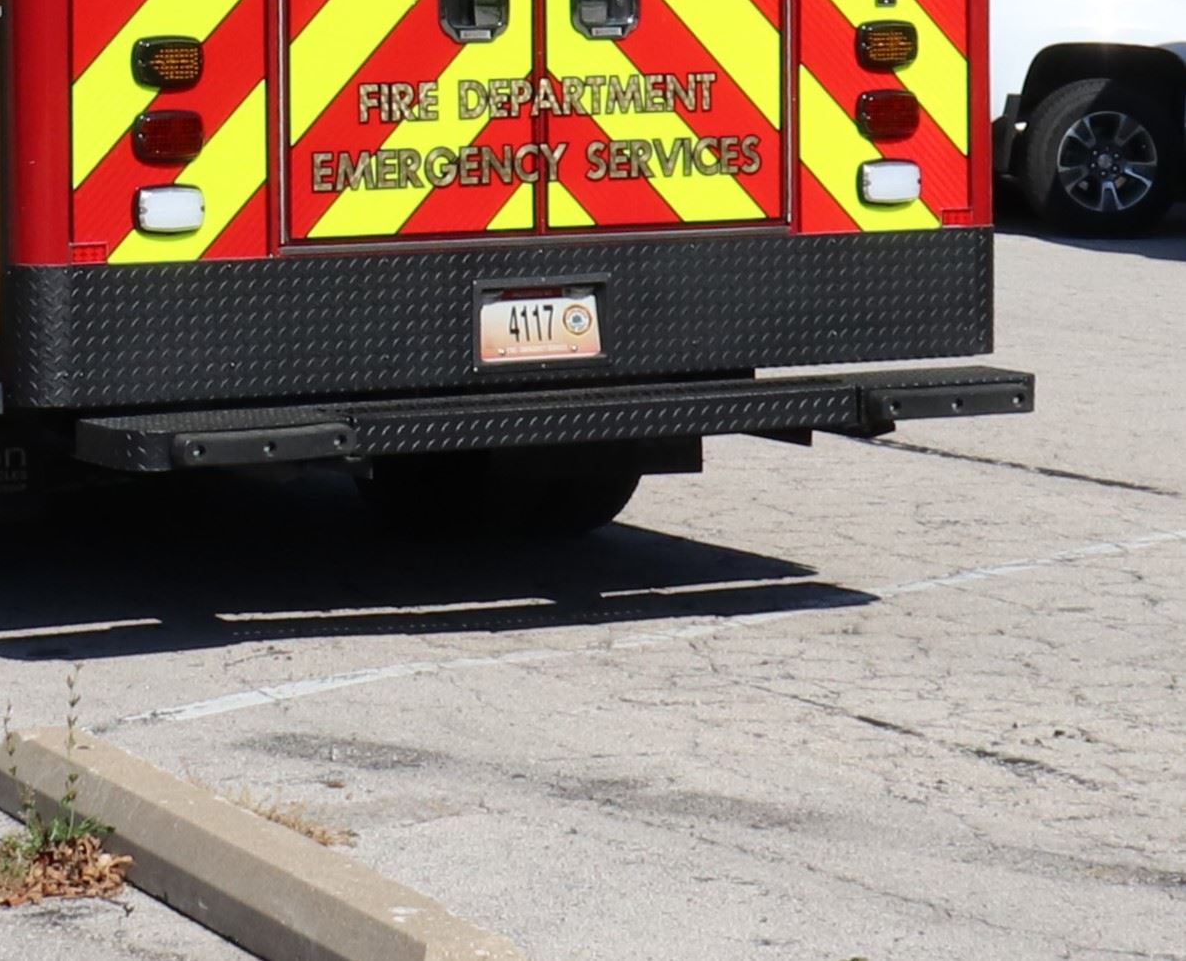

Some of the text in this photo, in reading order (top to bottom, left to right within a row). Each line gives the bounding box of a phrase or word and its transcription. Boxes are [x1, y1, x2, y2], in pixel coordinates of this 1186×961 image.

[358, 72, 716, 124] FIRE DEPARTMENT
[312, 135, 761, 193] EMERGENCY SERVICES
[509, 304, 554, 342] 4117
